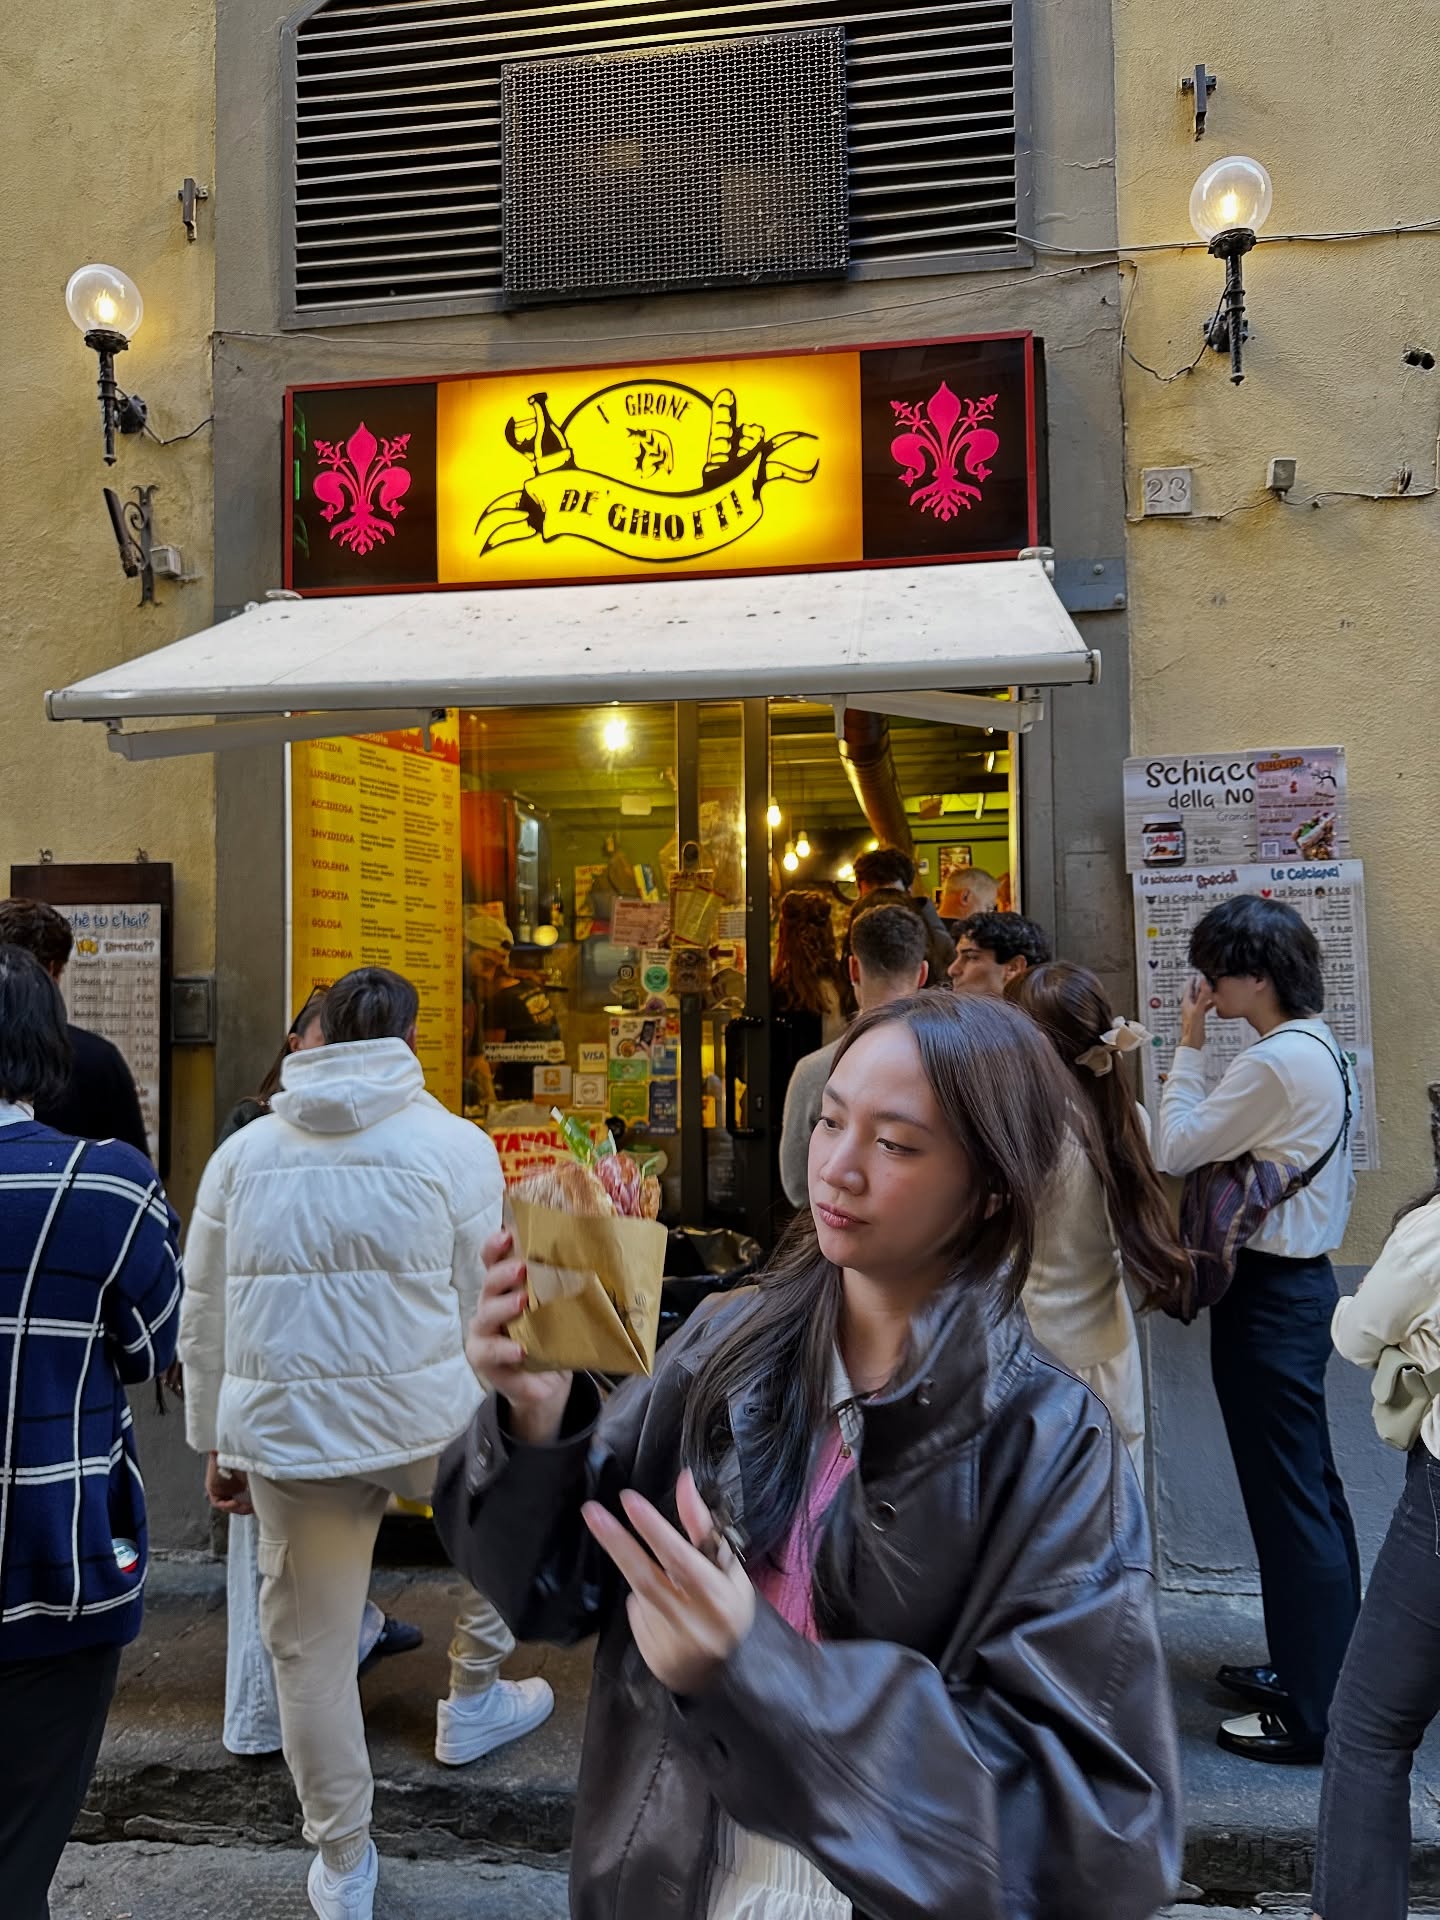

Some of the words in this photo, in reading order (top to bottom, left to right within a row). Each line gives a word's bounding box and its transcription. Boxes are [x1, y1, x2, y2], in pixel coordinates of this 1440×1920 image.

[625, 394, 693, 423] GIRONE
[1147, 476, 1187, 502] 23
[608, 488, 744, 541] GHIOTTI
[1168, 789, 1215, 809] della
[583, 1051, 605, 1060] VISA
